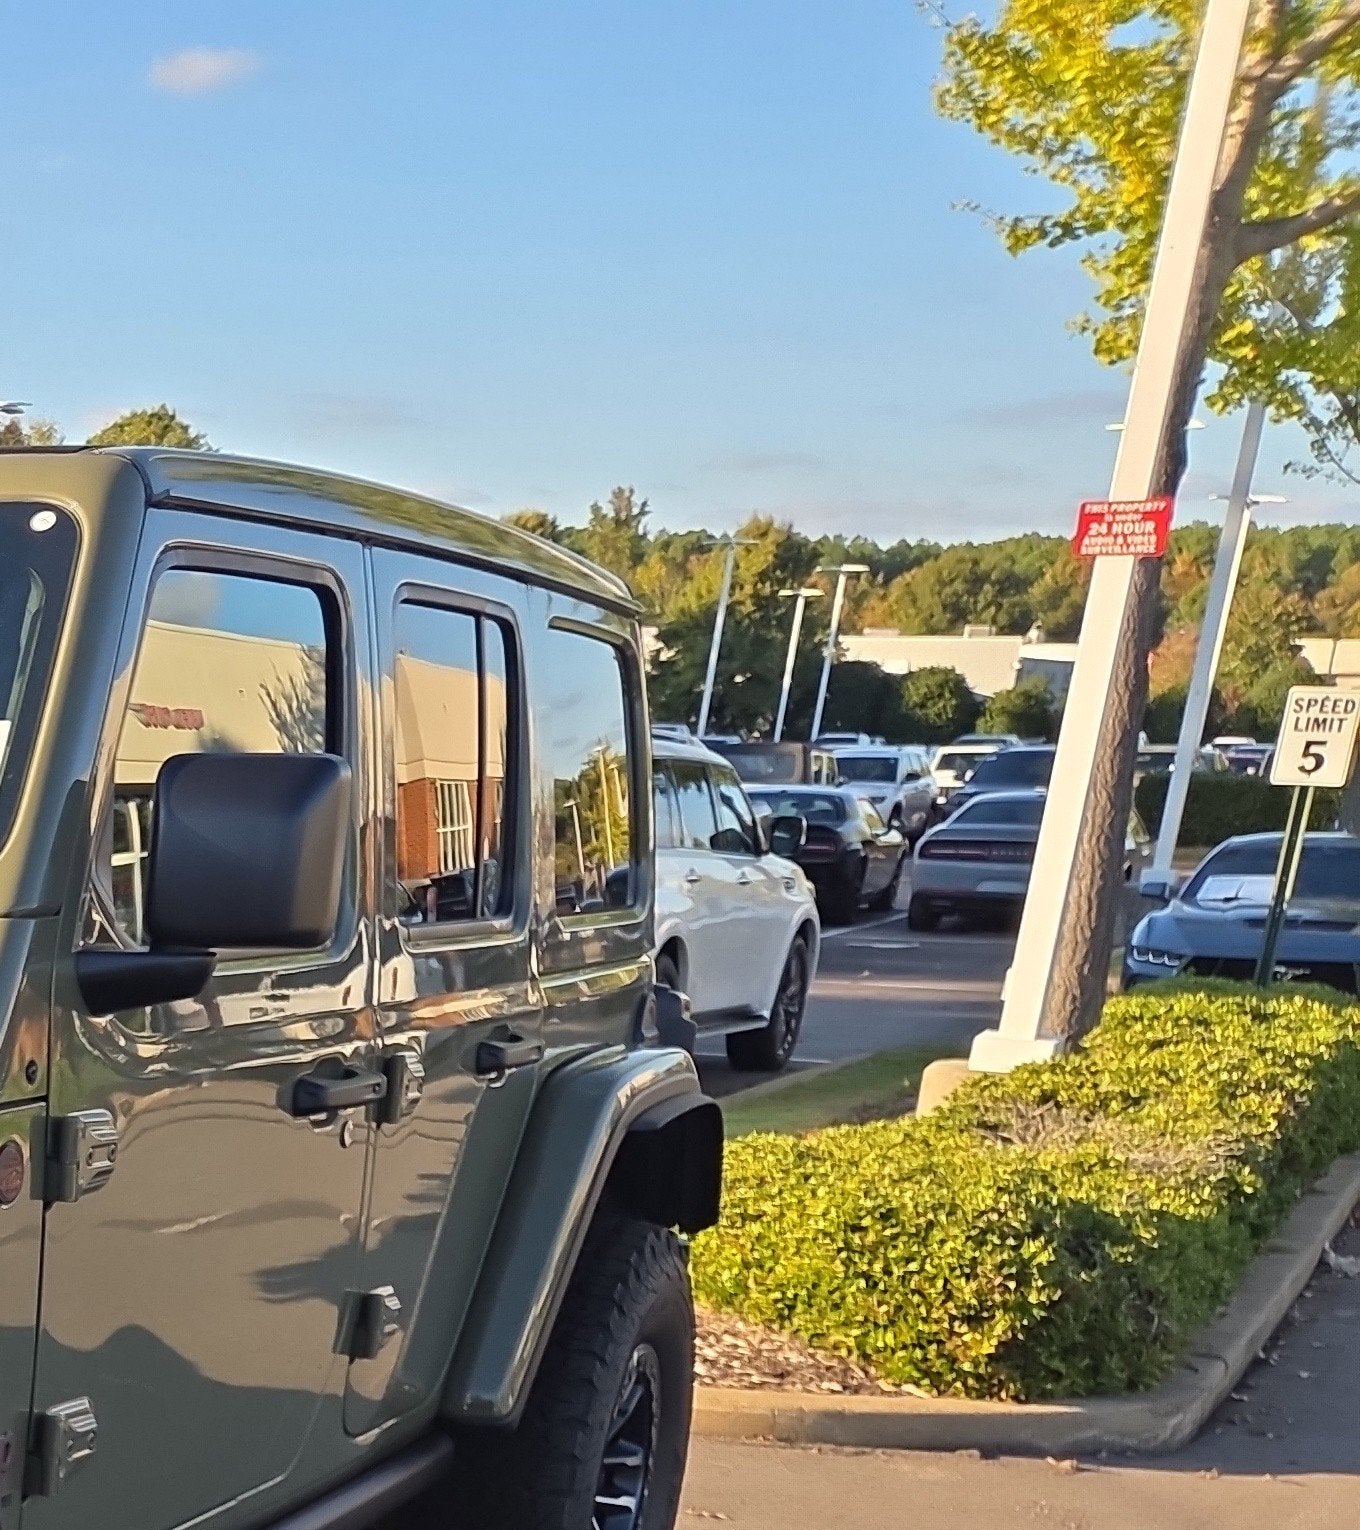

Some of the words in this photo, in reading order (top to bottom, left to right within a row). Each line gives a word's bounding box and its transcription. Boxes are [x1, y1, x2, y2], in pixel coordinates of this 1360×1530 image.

[1110, 501, 1168, 513] PROPERTY
[1087, 522, 1108, 535] 24
[1110, 520, 1156, 534] HOUR
[1293, 697, 1356, 714] SPEED
[1293, 716, 1348, 733] LIMIT
[1298, 740, 1328, 775] 5
